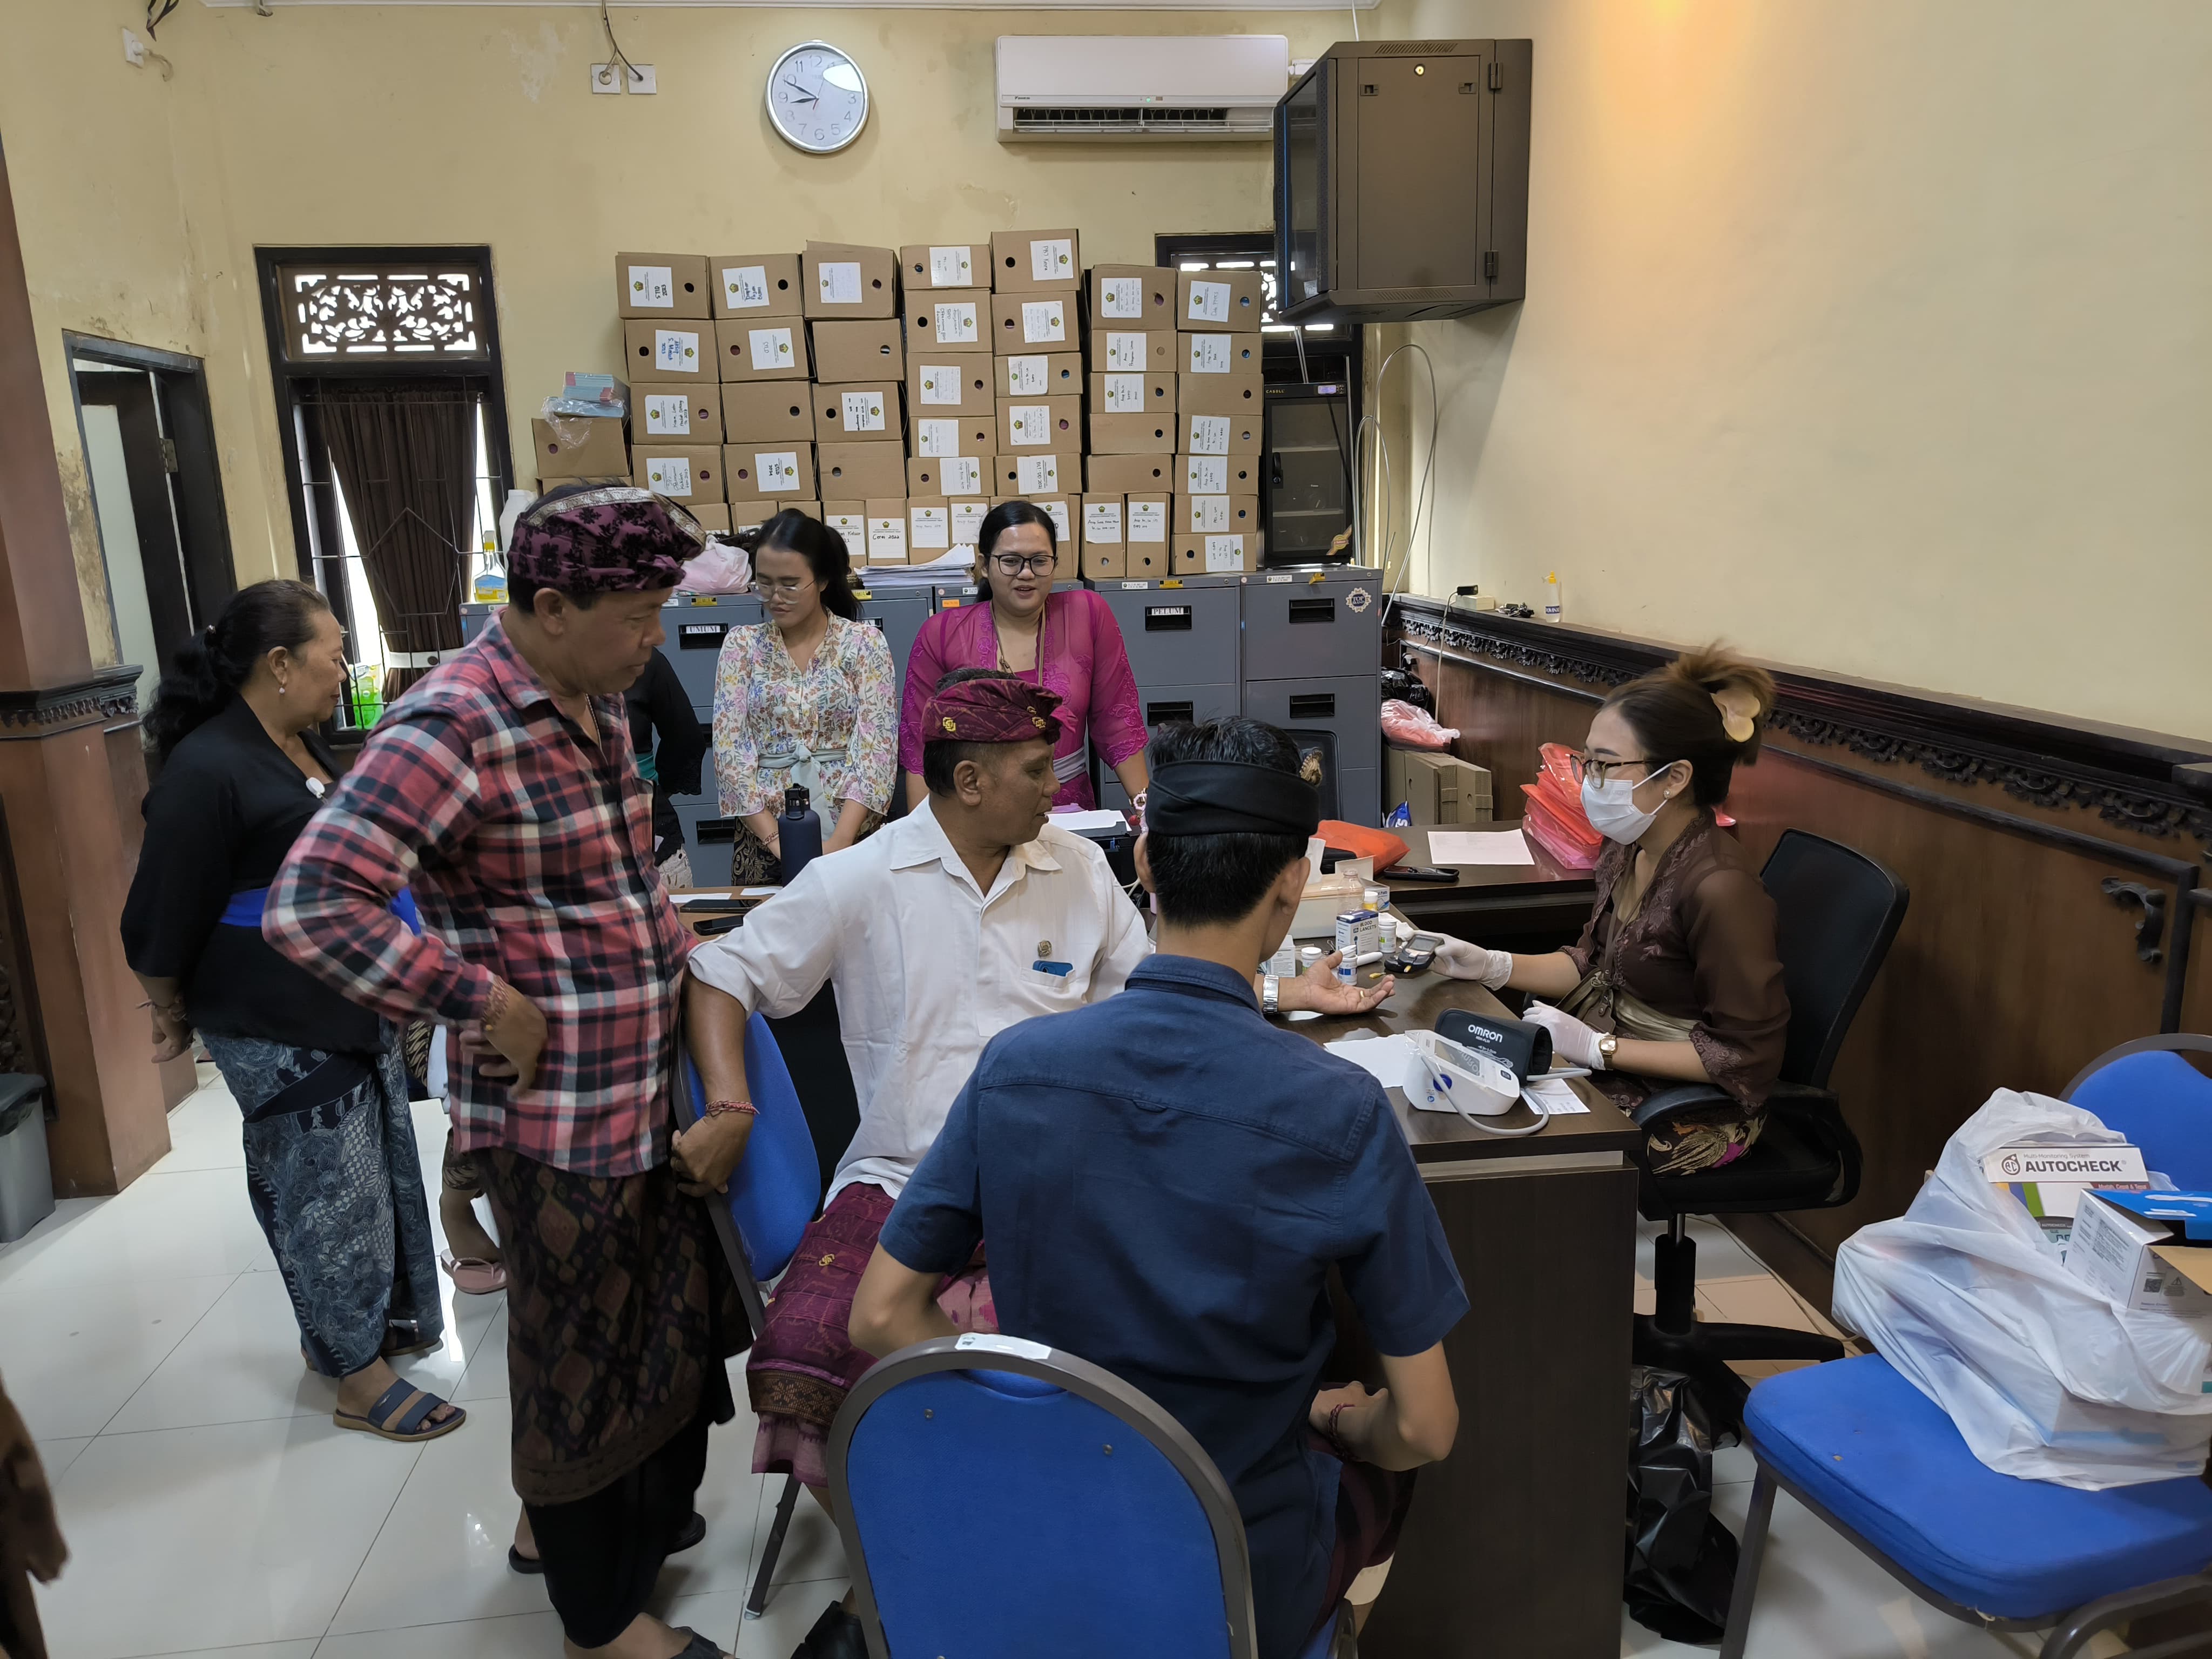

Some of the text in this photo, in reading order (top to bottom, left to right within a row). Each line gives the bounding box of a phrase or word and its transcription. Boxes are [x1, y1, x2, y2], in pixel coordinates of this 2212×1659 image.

[795, 60, 803, 72] 11
[809, 55, 822, 68] 12
[778, 91, 788, 103] 9
[847, 92, 857, 104] 3
[785, 110, 795, 122] 8
[844, 111, 851, 122] 4
[798, 123, 807, 135] 7
[814, 129, 825, 140] 6
[831, 123, 840, 135] 5
[1468, 1024, 1503, 1043] OMRON
[2025, 1161, 2122, 1172] AUTOCHECK
